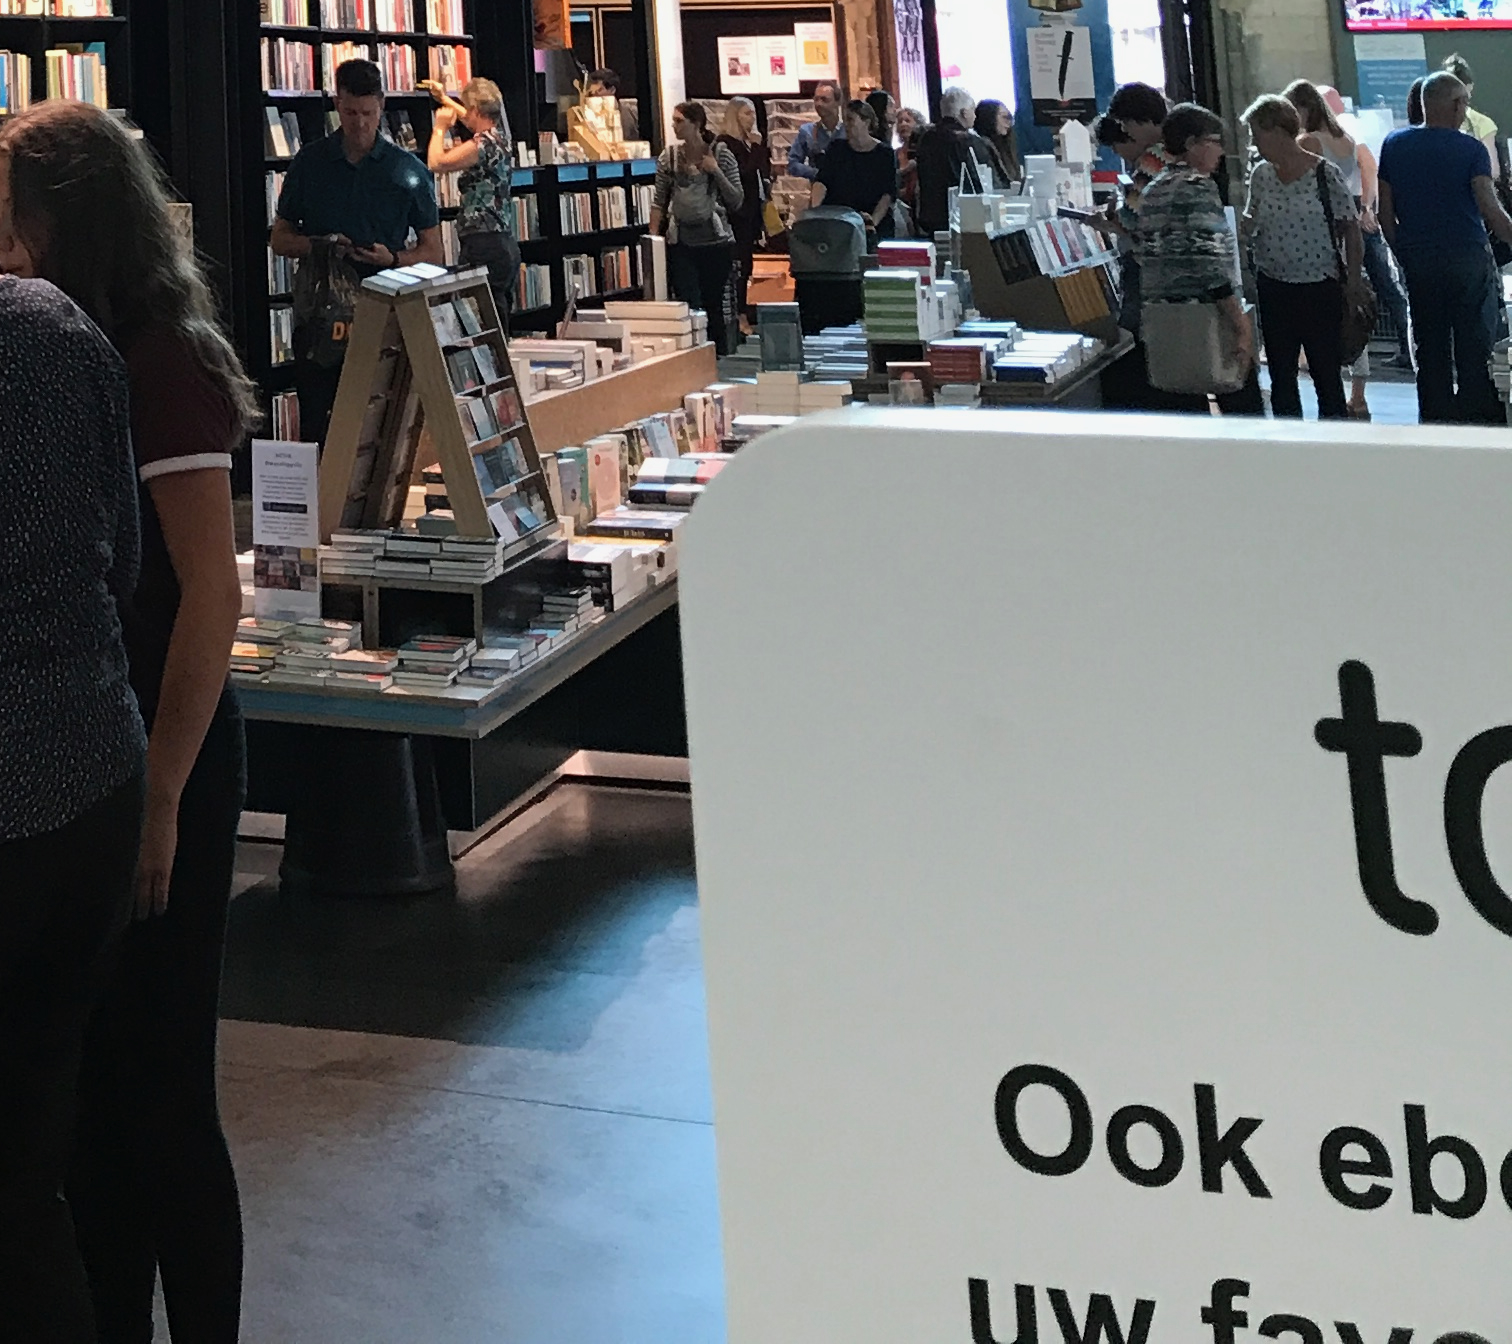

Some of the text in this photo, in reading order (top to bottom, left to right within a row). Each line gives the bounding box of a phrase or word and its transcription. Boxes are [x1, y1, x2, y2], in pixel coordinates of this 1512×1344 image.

[993, 1063, 1512, 1220] Ook eb
[967, 1276, 1157, 1344] uw
